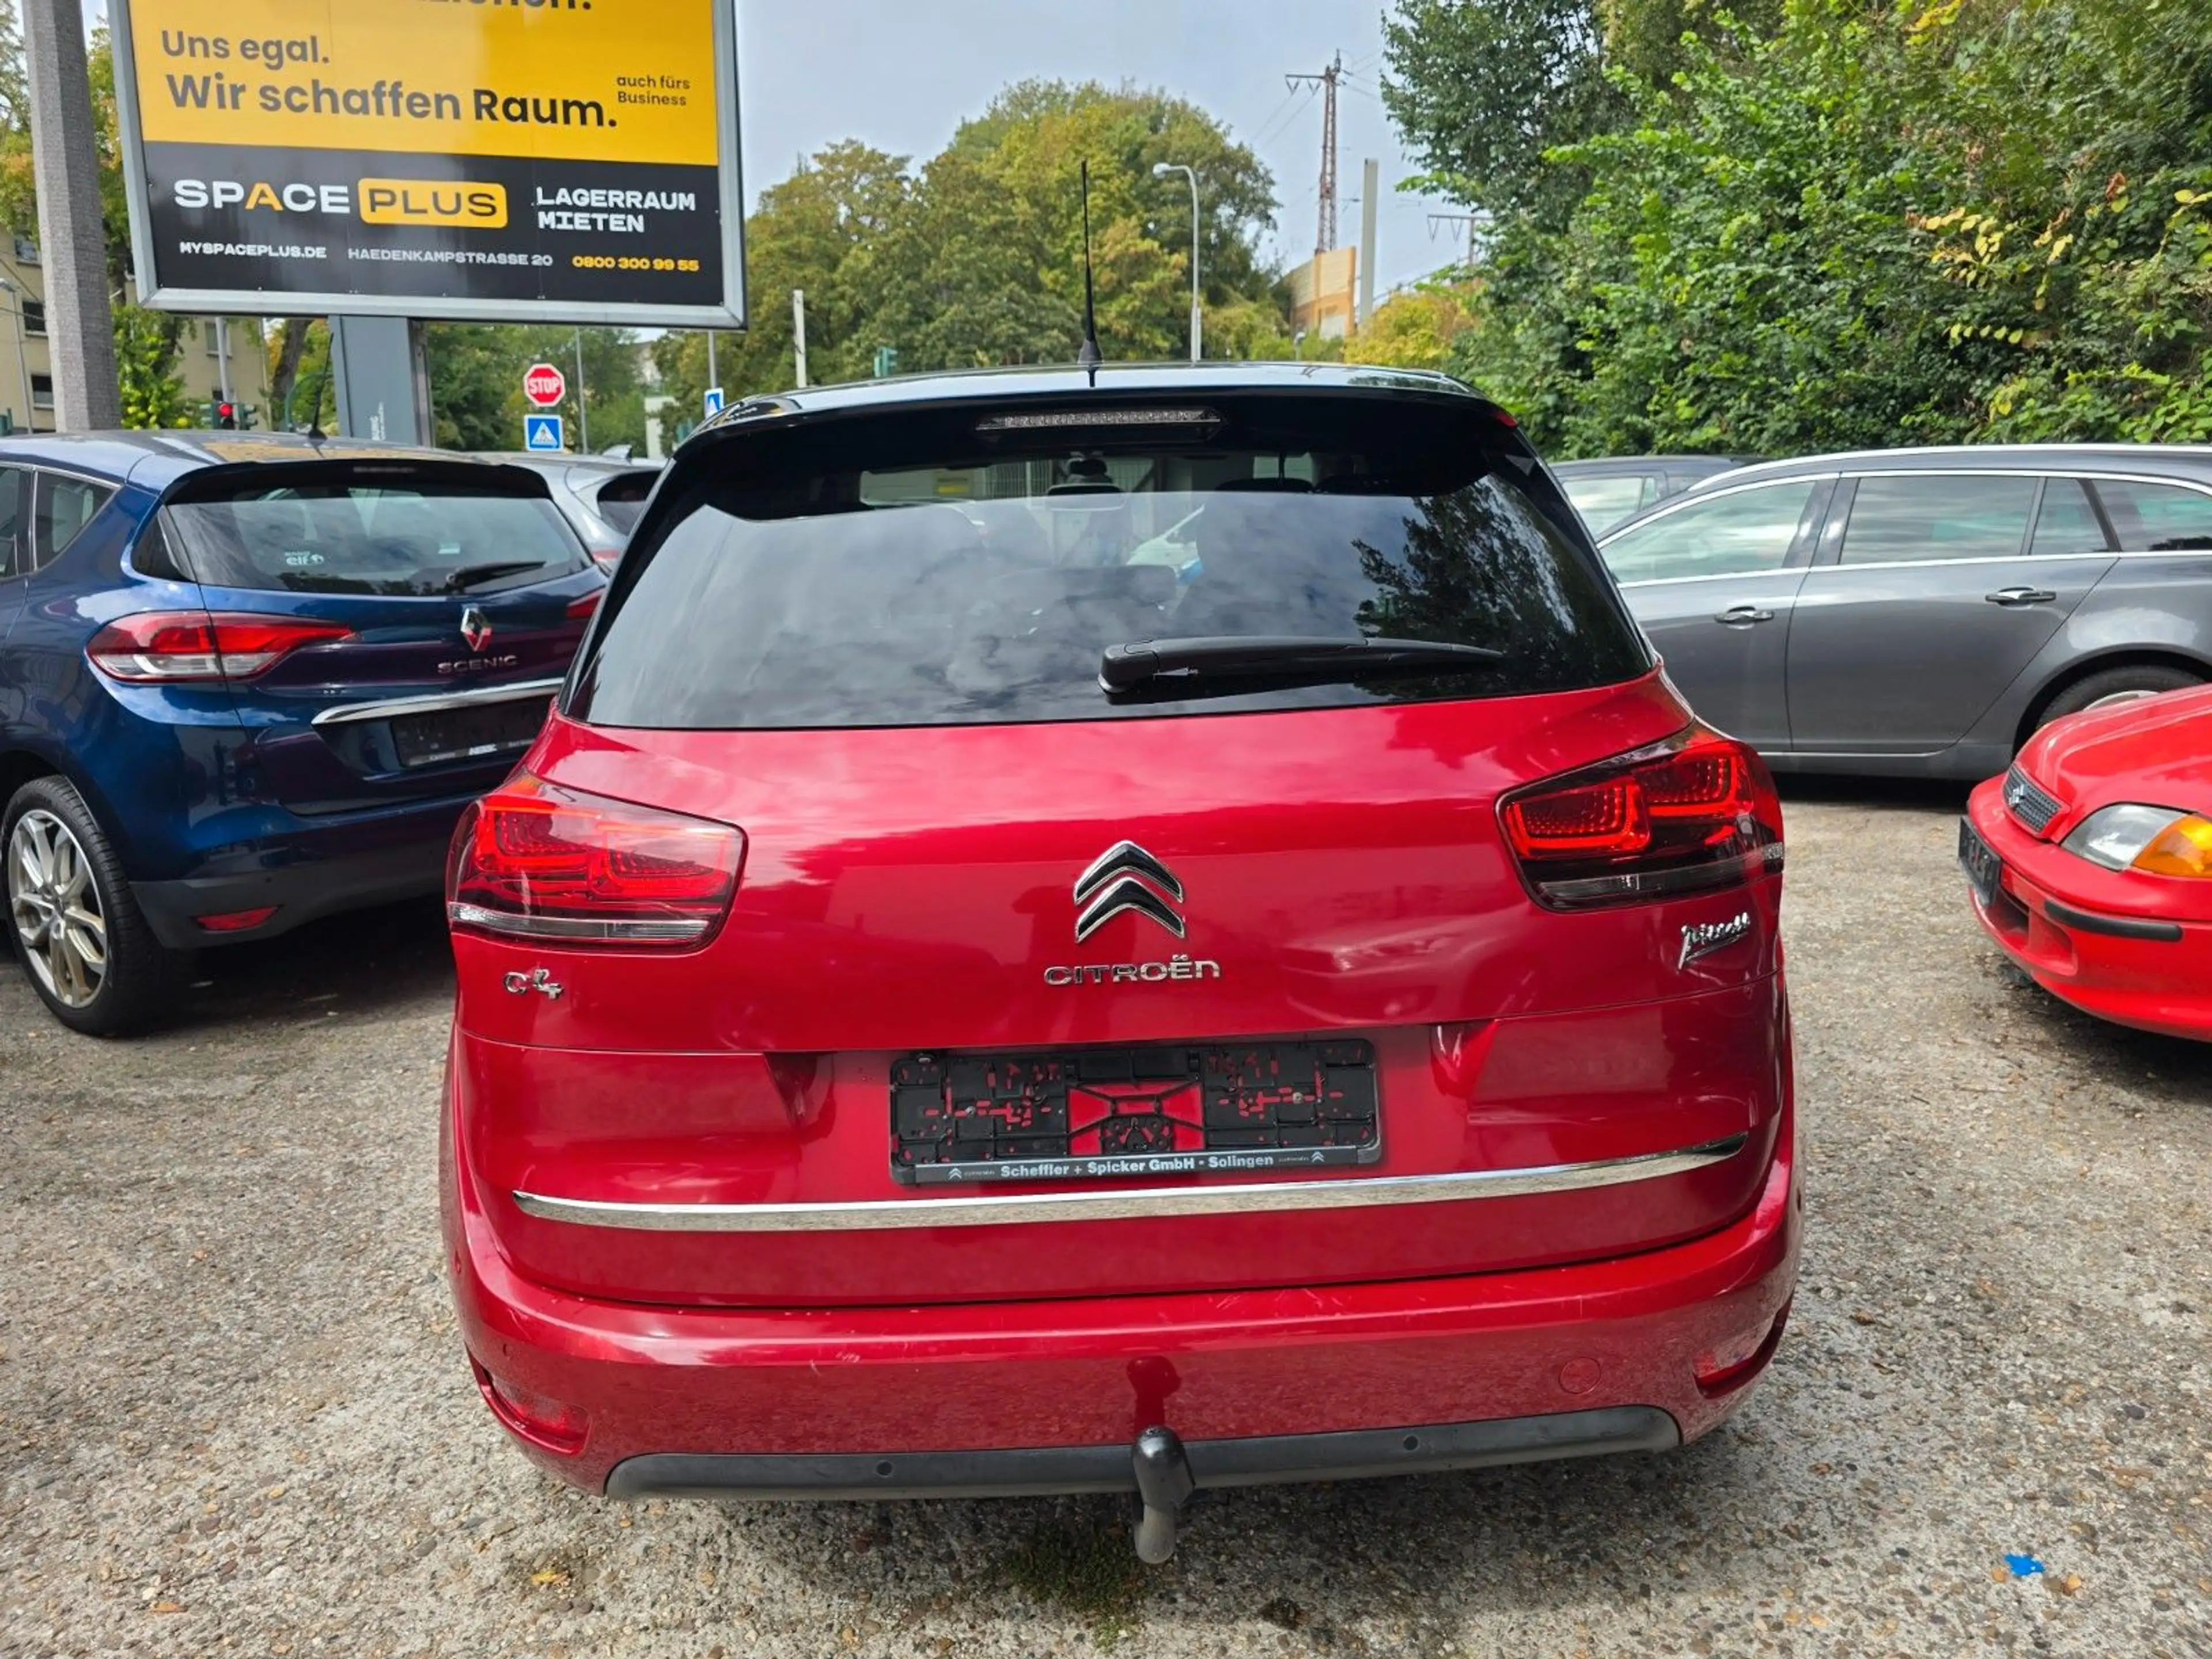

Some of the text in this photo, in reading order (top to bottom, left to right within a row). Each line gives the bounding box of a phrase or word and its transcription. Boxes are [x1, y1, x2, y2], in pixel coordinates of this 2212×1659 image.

[162, 30, 329, 70] Uns egal.
[616, 75, 690, 89] auch fürs
[165, 72, 618, 127] Wir schaffen Raum.
[618, 90, 686, 106] Business
[174, 179, 497, 217] SPACE PLUS
[536, 187, 696, 211] LAGERRAUM
[538, 211, 645, 233] MIETEN
[180, 241, 700, 272] MYSPACEPLUS.DE HAEDENKAMPSTRASSE 20 0800 300 99 55
[529, 377, 560, 394] STOP
[286, 555, 309, 566] elf
[437, 655, 518, 674] SCENIC
[1044, 953, 1221, 986] CITROËN
[504, 969, 564, 999] C4
[1000, 1163, 1069, 1178] Scheffler
[1074, 1165, 1082, 1175] +
[1087, 1160, 1146, 1176] Spicker
[1149, 1157, 1195, 1171] GmbH
[1208, 1154, 1274, 1168] Solingen
